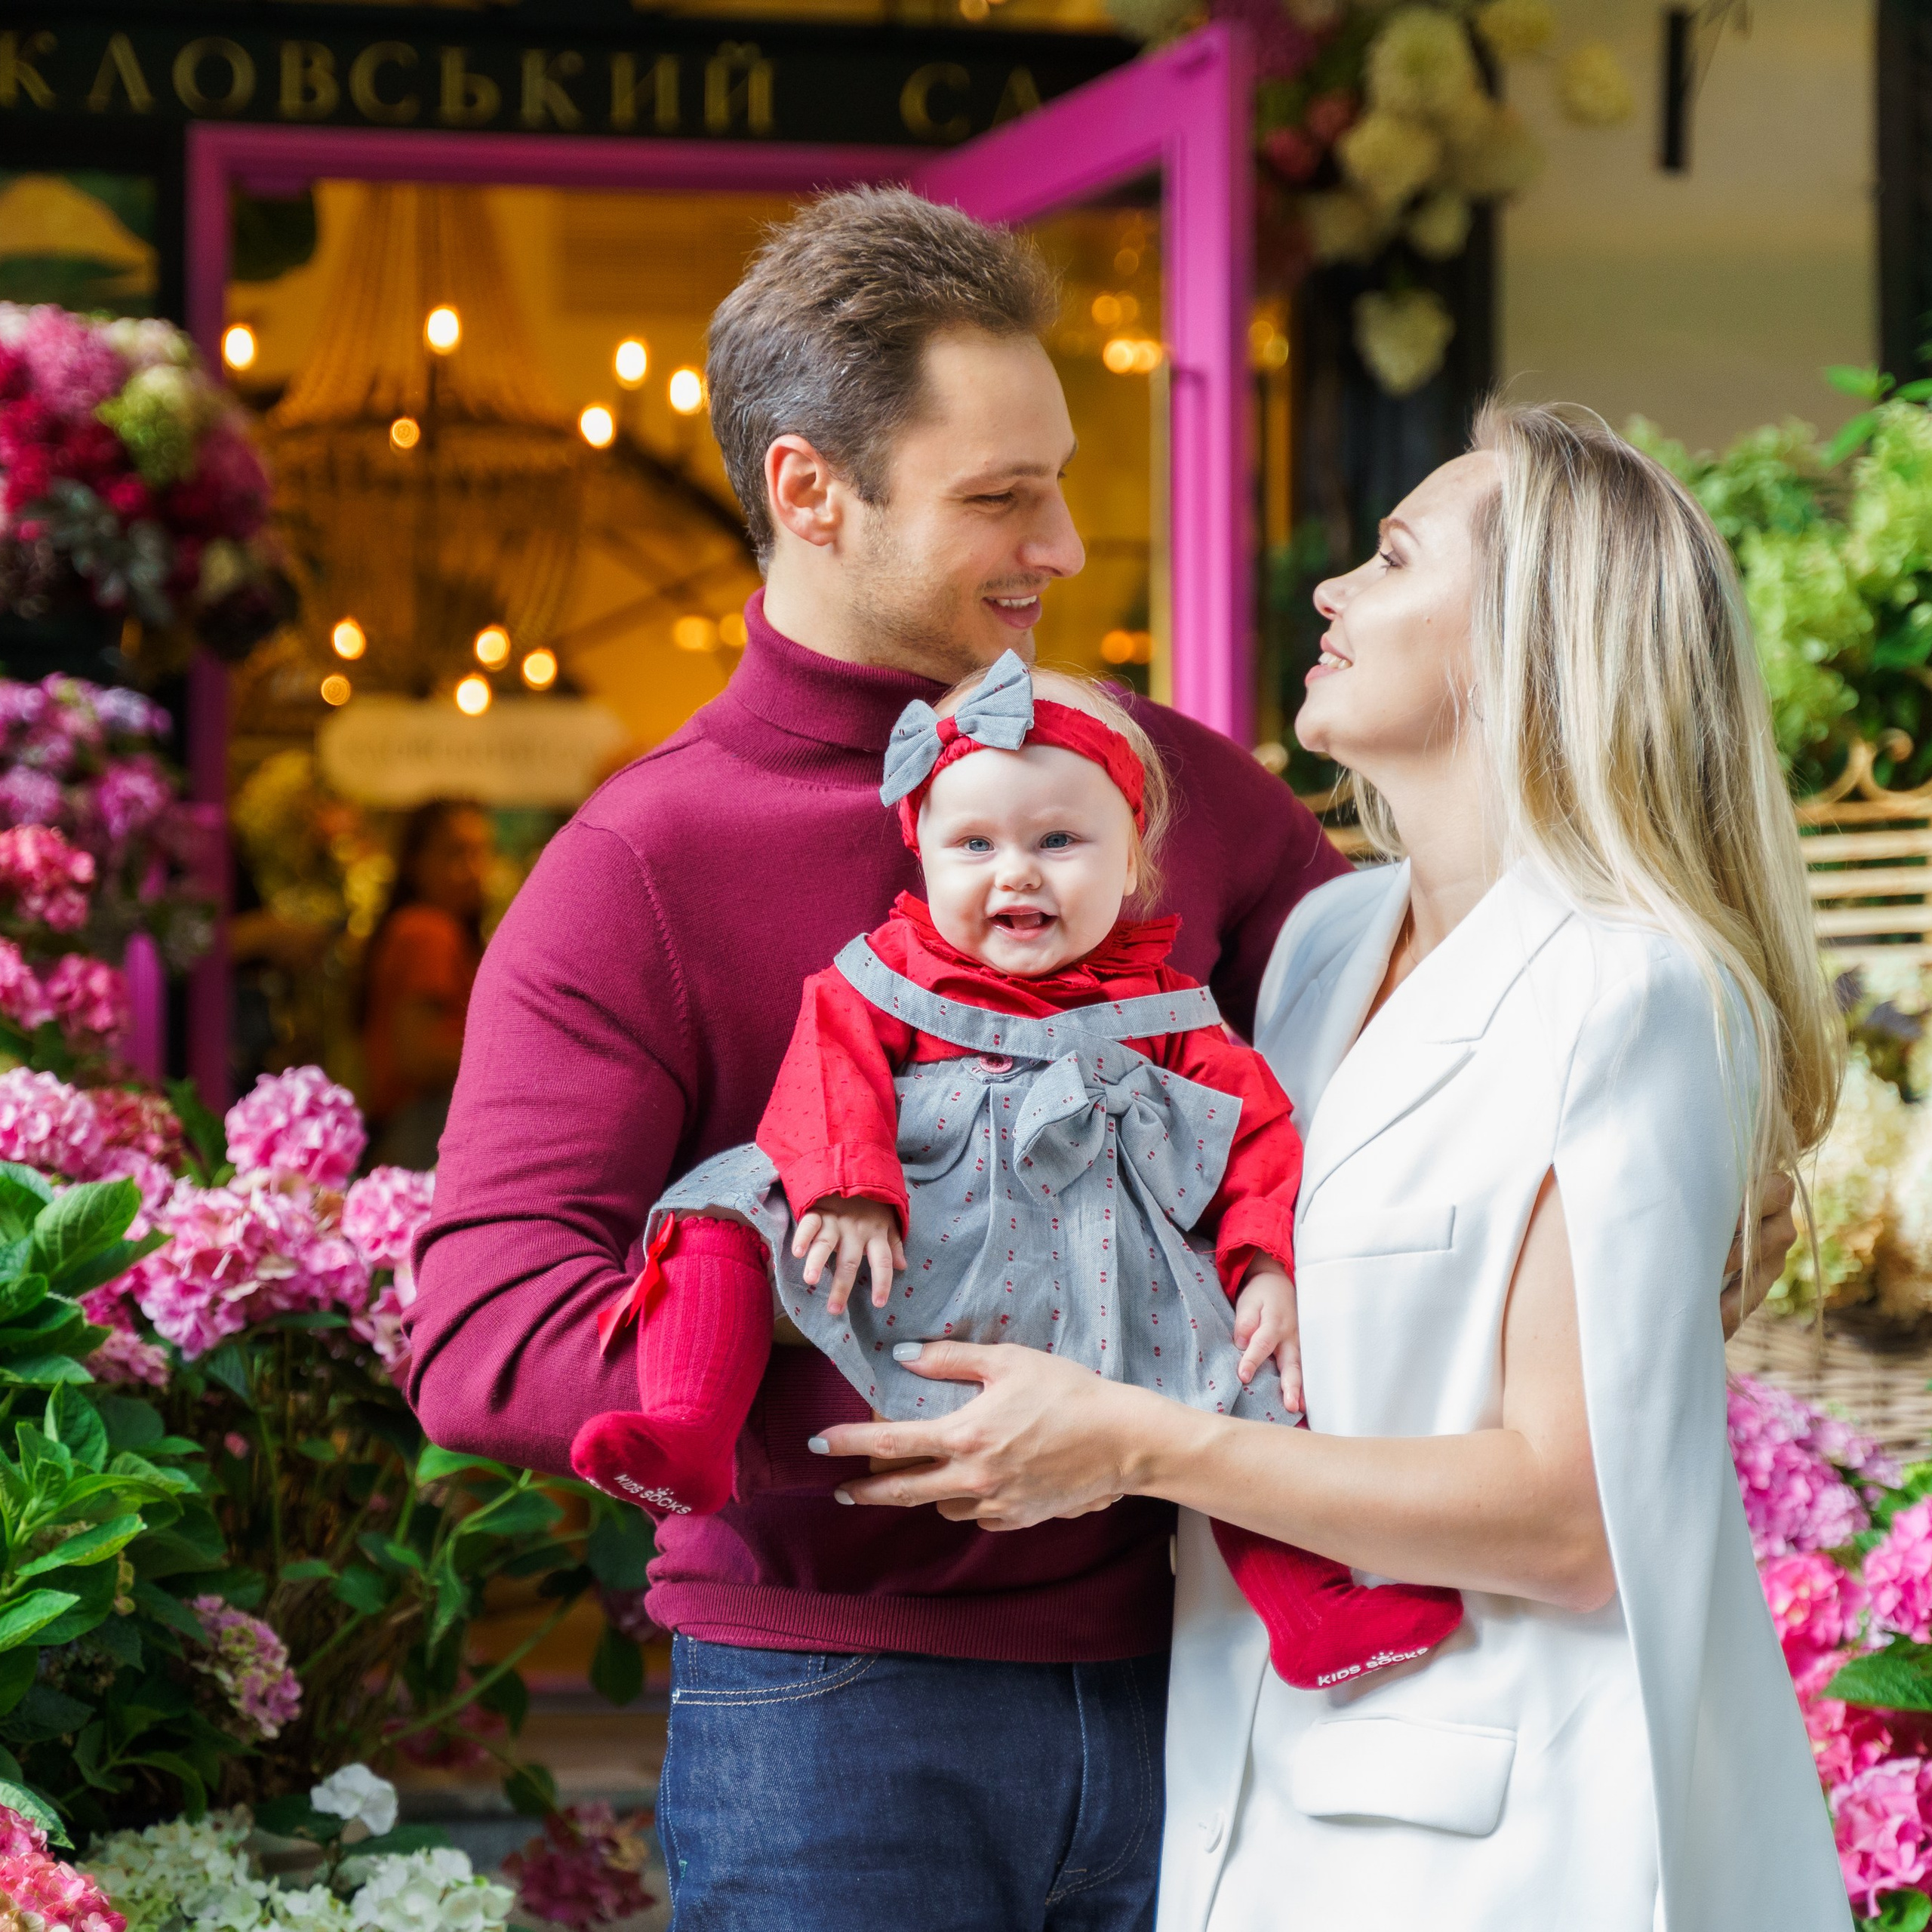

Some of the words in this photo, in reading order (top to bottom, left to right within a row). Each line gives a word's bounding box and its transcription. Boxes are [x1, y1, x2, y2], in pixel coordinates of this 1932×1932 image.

[614, 1474, 644, 1494] KIDS
[638, 1490, 692, 1515] SOCKS
[1318, 1664, 1361, 1686] KIDS
[1366, 1647, 1429, 1669] SOCKS
